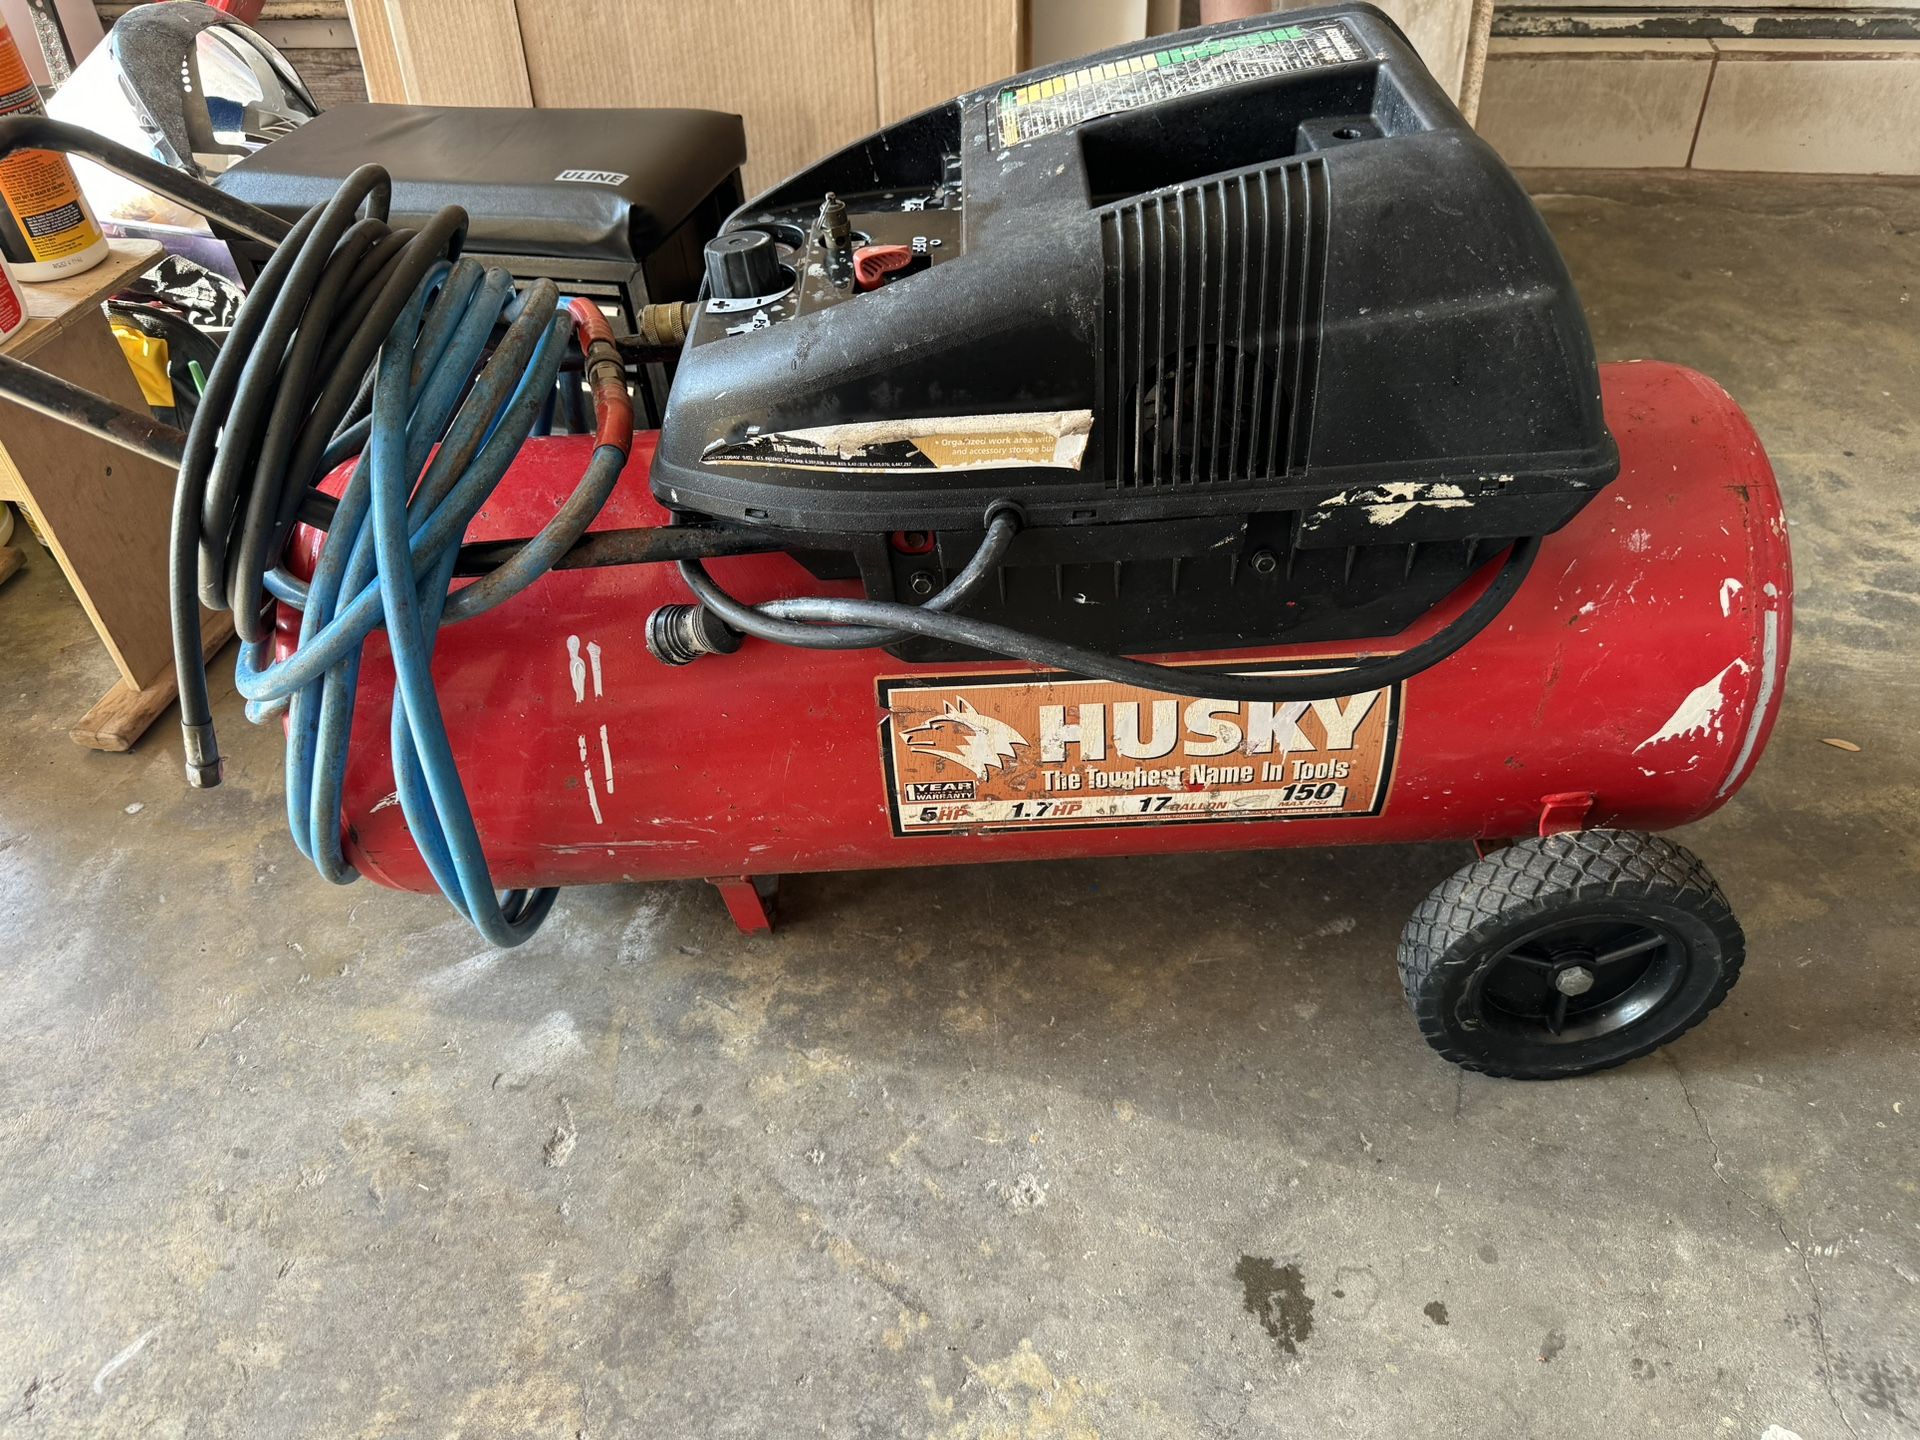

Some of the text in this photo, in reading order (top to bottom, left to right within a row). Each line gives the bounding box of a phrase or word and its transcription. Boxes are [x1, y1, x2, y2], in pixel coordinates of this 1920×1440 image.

[562, 171, 623, 183] ULINE
[988, 436, 1011, 445] work
[1013, 436, 1033, 444] area
[951, 447, 967, 456] and
[969, 447, 1007, 456] accessory
[1009, 446, 1039, 455] storage
[1039, 690, 1381, 763] HUSKY
[1042, 758, 1350, 792] The Toughest Name In Tools
[904, 784, 916, 800] 1
[915, 782, 972, 792] YEAR
[915, 792, 973, 801] WARRANTY
[1282, 782, 1337, 801] 150
[1011, 801, 1083, 818] 1.7 HP
[1139, 796, 1228, 813] 17 GALLON
[920, 806, 969, 822] 5 HP
